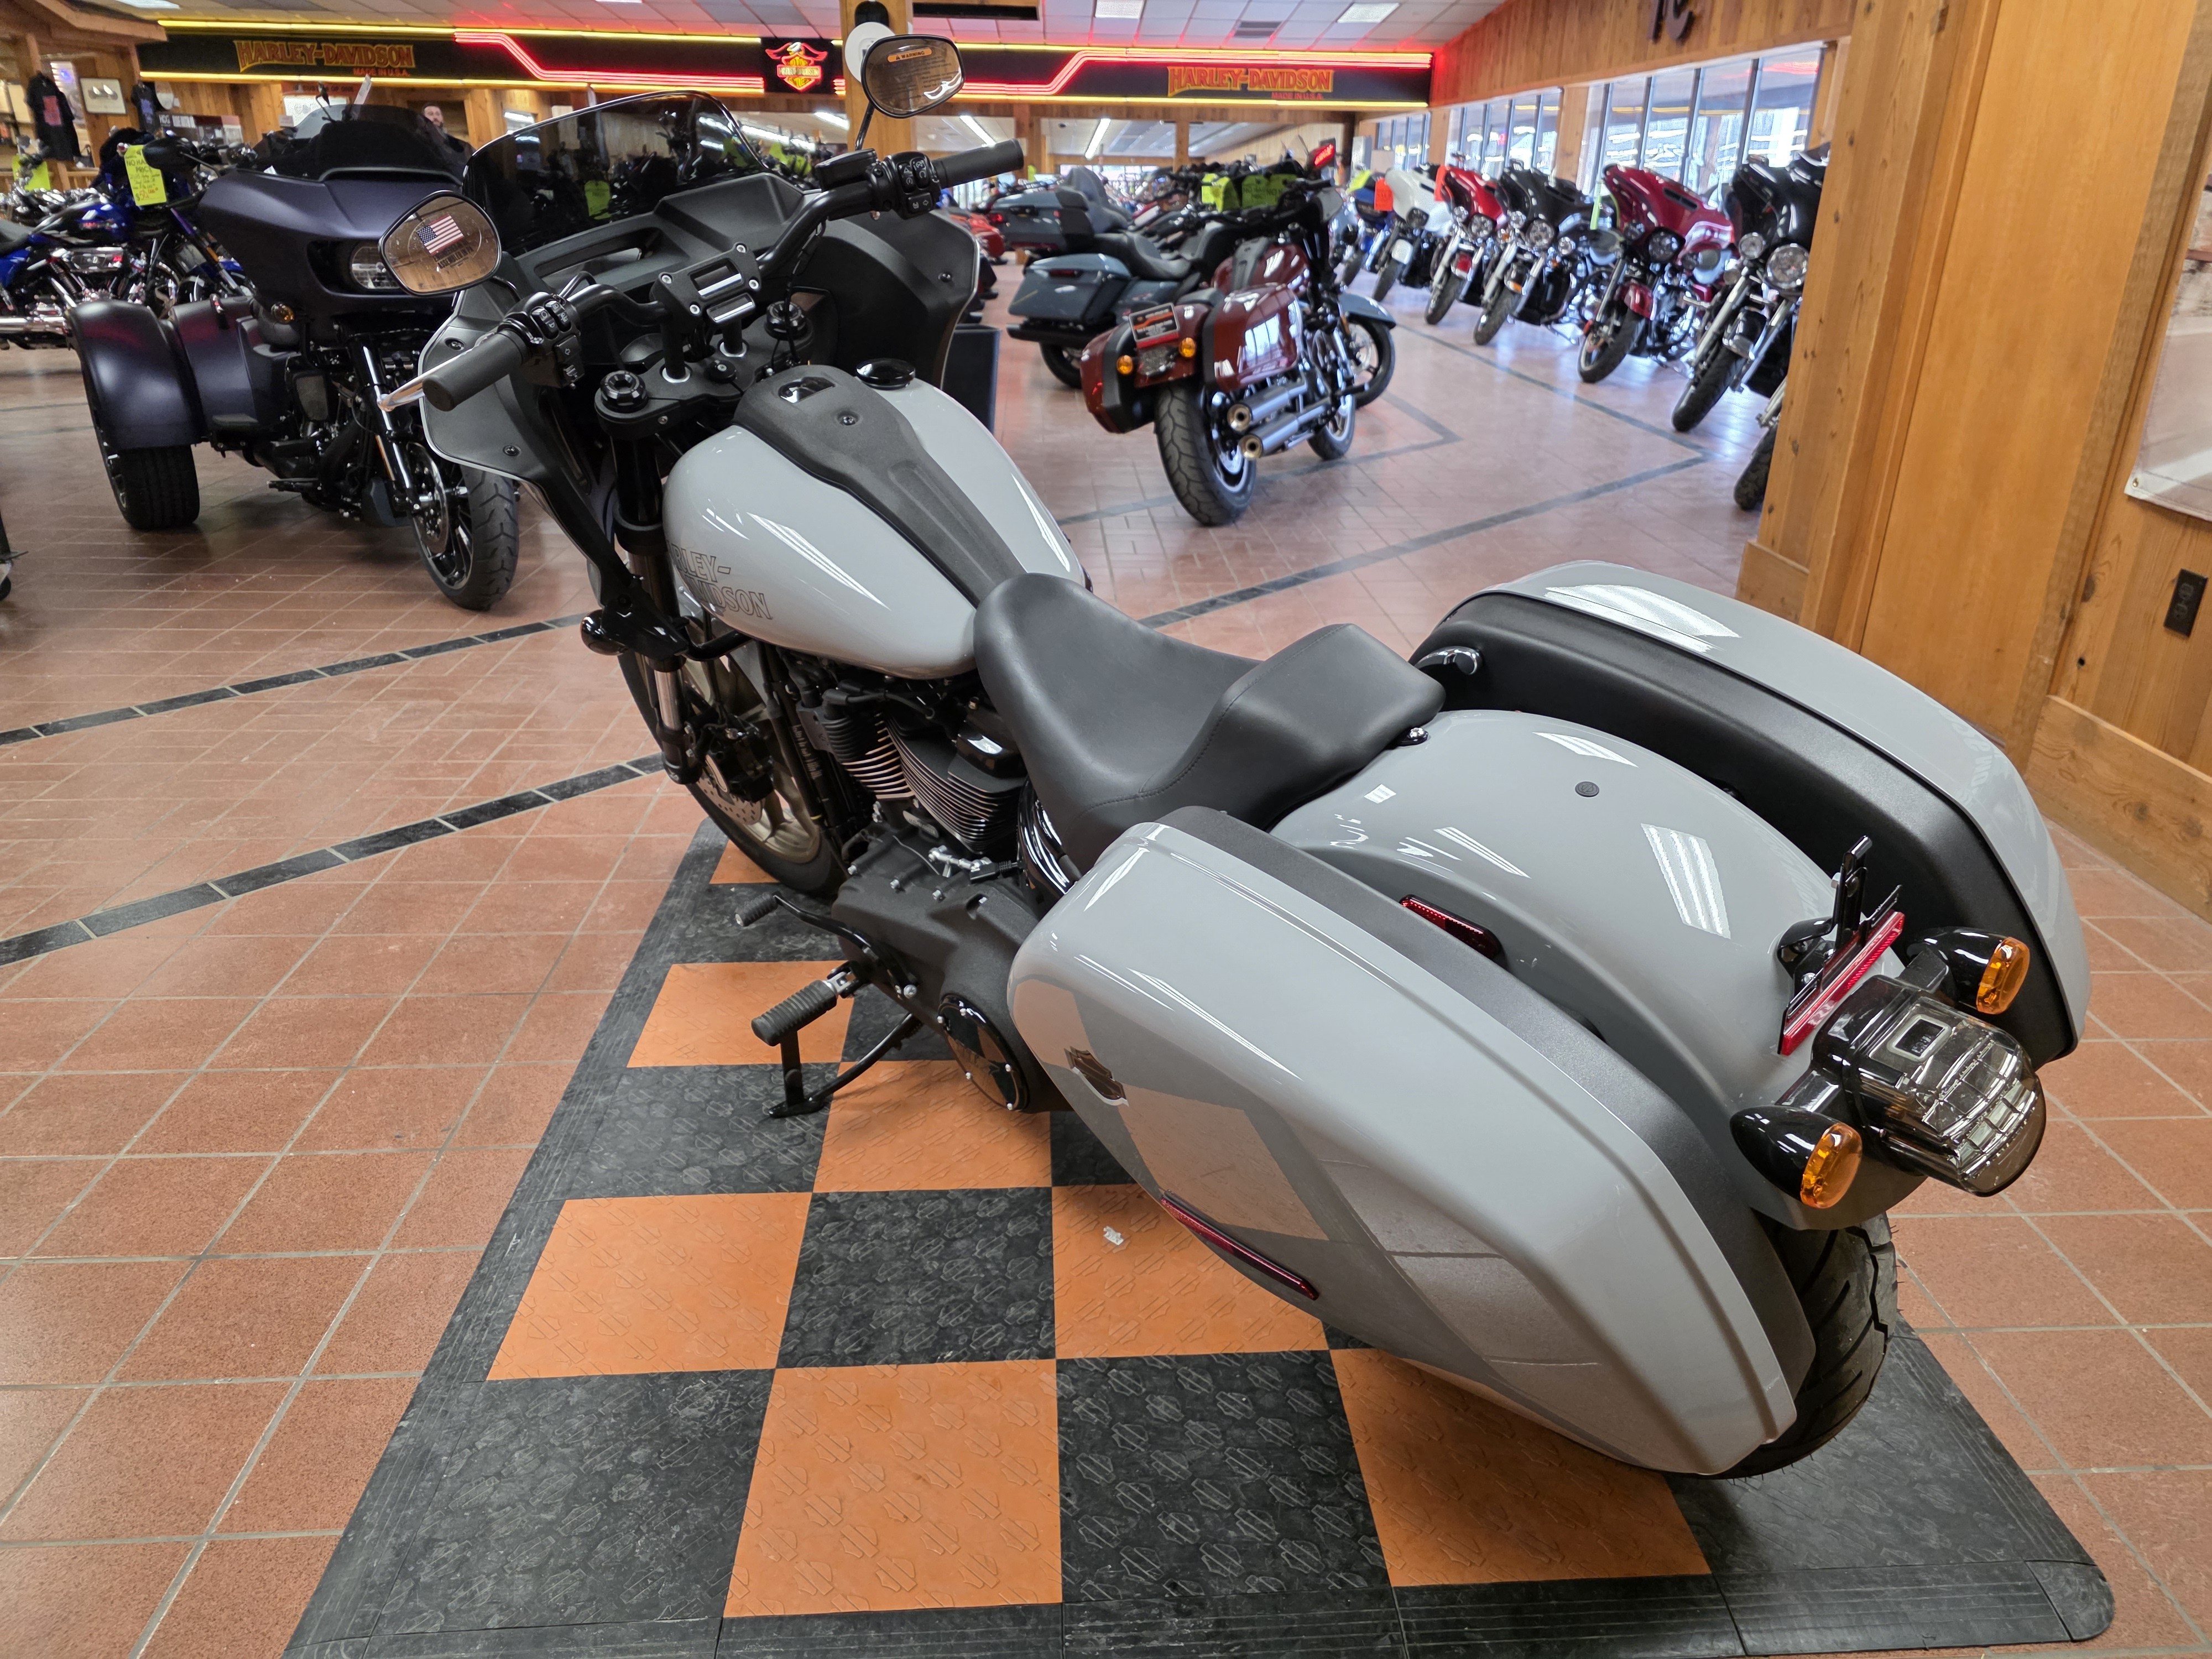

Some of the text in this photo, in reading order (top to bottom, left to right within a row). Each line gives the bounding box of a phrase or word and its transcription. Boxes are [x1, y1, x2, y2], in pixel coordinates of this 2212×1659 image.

[233, 40, 416, 73] HARLEY-DAVIDSON
[901, 51, 925, 59] WARNING
[1167, 66, 1334, 97] HARLEY-DAVIDSON
